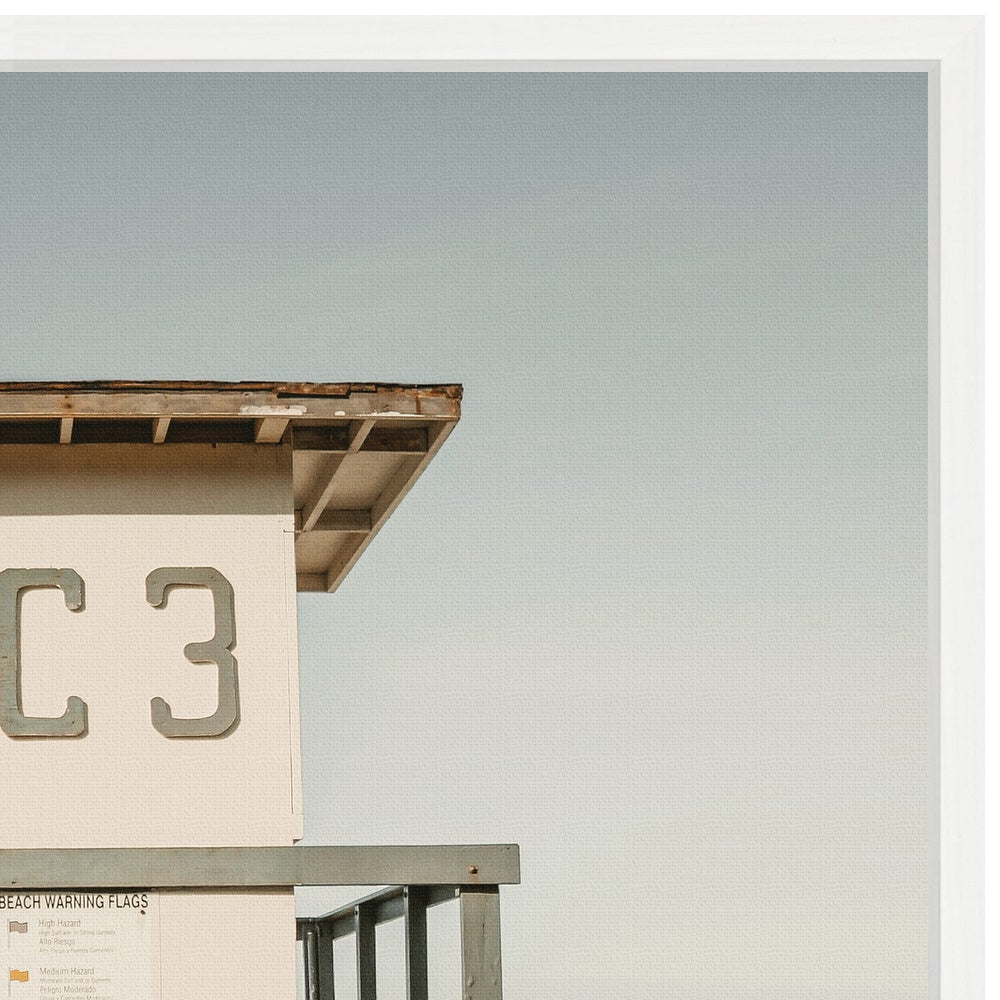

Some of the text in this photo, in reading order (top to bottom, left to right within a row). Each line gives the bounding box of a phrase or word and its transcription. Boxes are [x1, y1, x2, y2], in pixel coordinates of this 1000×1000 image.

[146, 567, 238, 740] 3
[45, 894, 104, 909] WARNING
[108, 894, 149, 909] FLAGS
[57, 919, 81, 928] Hazard
[39, 967, 95, 976] Medium Hazard
